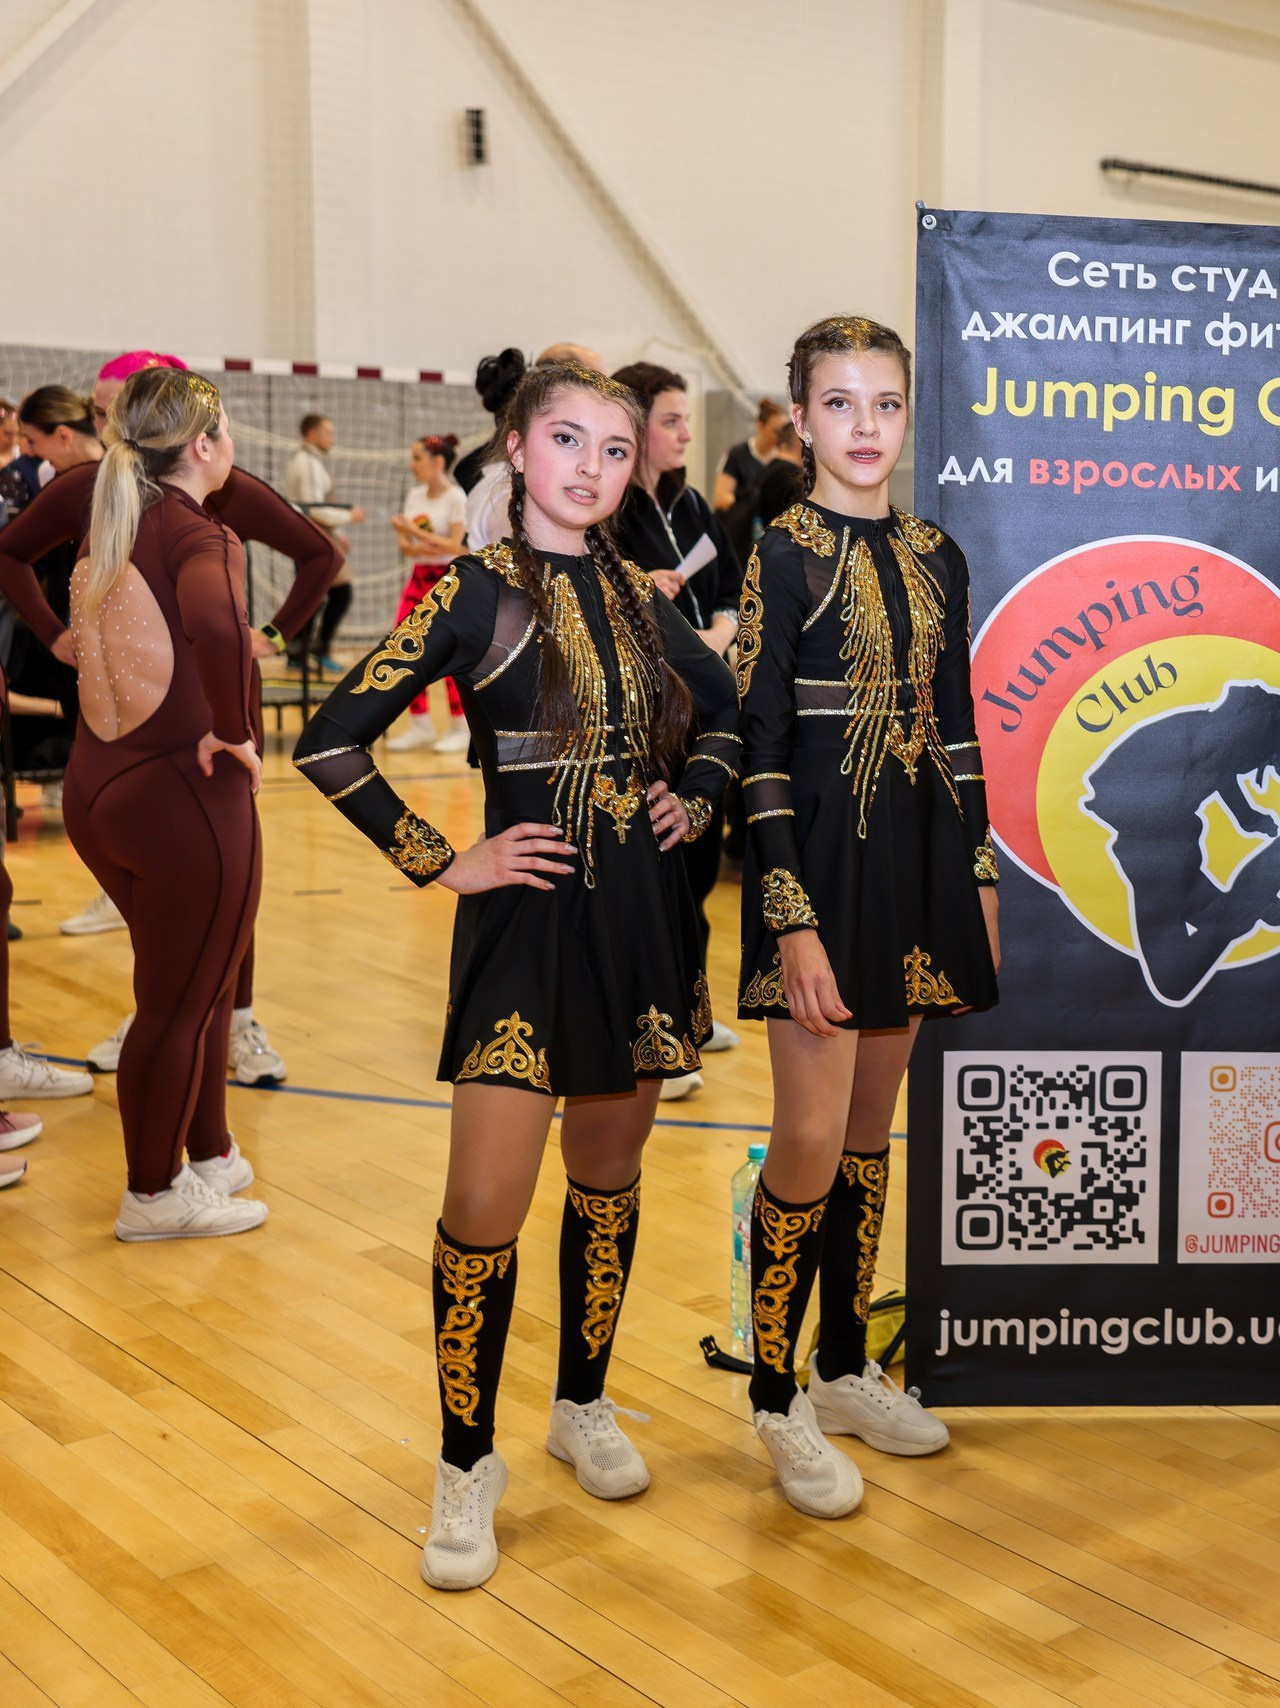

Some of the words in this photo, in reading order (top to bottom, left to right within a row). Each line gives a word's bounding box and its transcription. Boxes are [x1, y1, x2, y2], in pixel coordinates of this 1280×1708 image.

[1047, 251, 1157, 289] Сеть
[961, 310, 1192, 345] джампинг
[971, 367, 1236, 437] Jumping
[937, 455, 1013, 486] для
[1029, 456, 1242, 494] взрослых
[1255, 466, 1279, 493] и
[981, 565, 1204, 733] Jumping
[1074, 654, 1179, 734] Club
